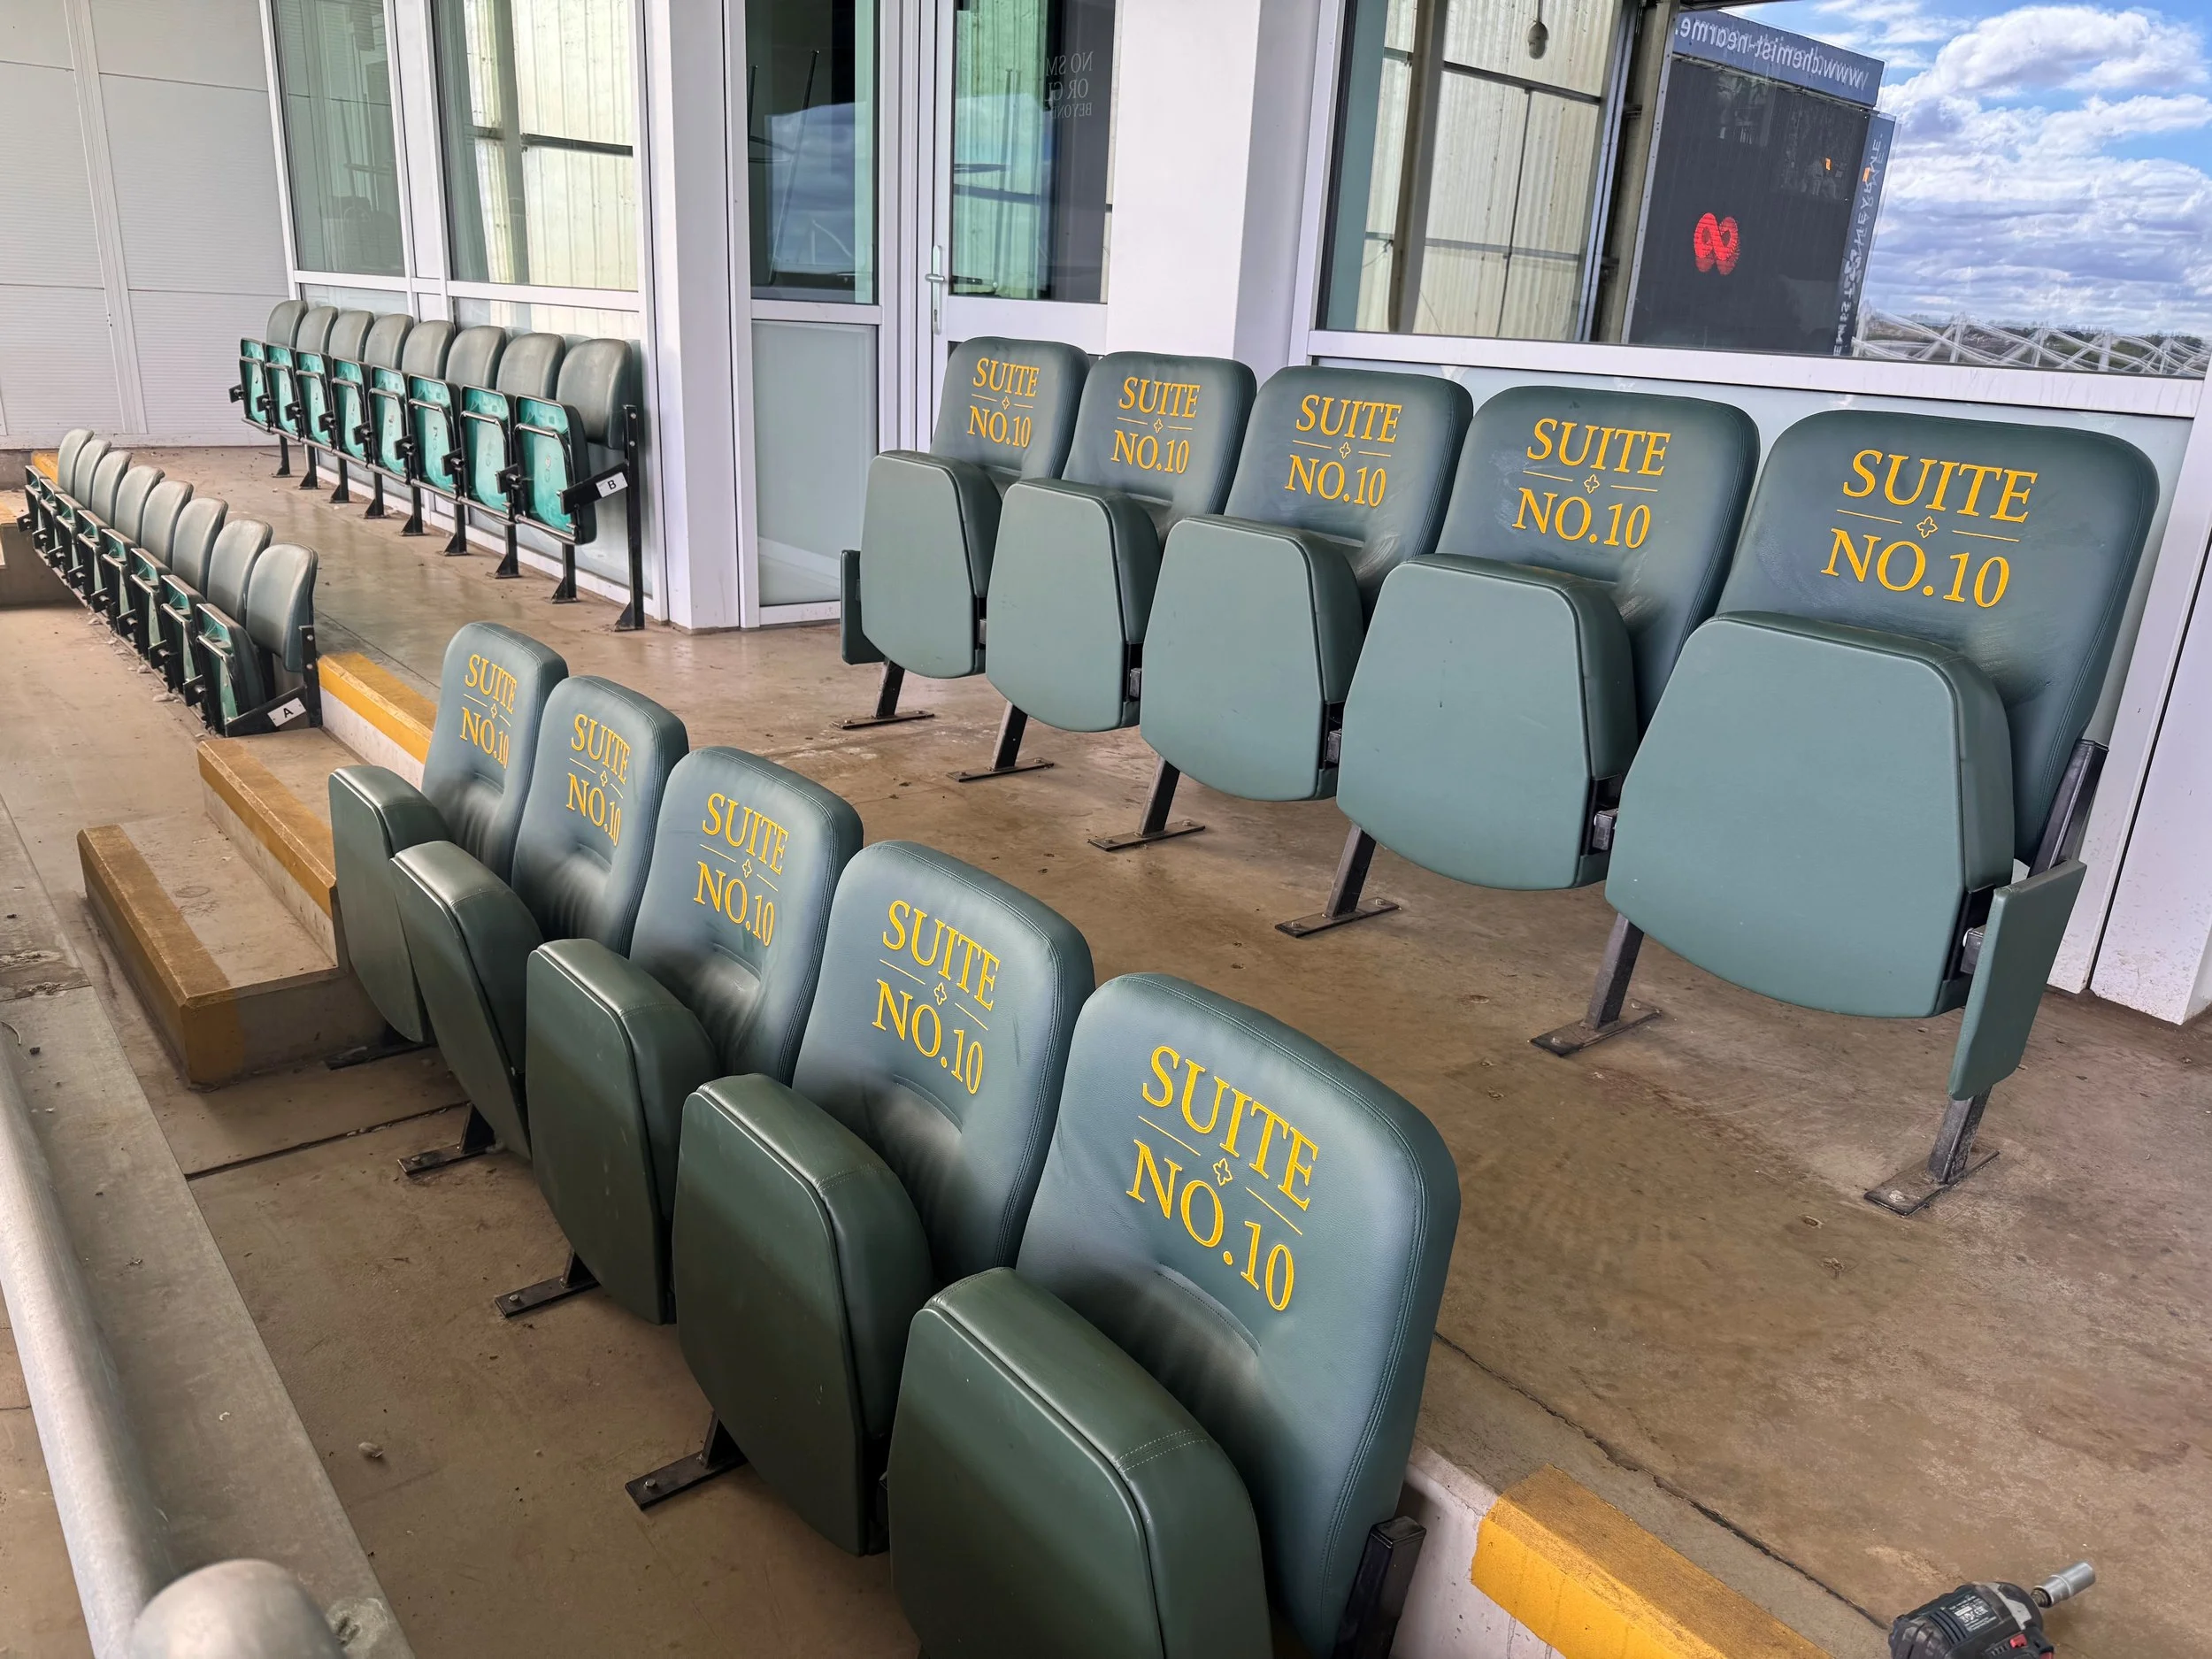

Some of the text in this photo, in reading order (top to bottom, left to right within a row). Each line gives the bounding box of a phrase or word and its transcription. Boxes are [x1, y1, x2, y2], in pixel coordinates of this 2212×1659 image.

[974, 357, 1040, 398] SUITE
[1119, 376, 1202, 419] SUITE
[968, 405, 1033, 449] NO.10
[1295, 394, 1402, 444] SUITE
[1526, 418, 1671, 477] SUITE
[1112, 429, 1190, 474] NO.10
[1286, 454, 1387, 509] NO.10
[608, 480, 617, 490] B
[1842, 449, 2039, 524] SUITE
[1513, 487, 1652, 552] NO.10
[1822, 527, 2011, 609] NO.10
[283, 707, 294, 718] A
[465, 654, 518, 715] SUITE
[460, 707, 509, 771] NO.10
[571, 714, 631, 784] SUITE
[566, 773, 622, 847] NO.10
[702, 792, 789, 876] SUITE
[695, 861, 775, 946] NO.10
[882, 900, 1001, 1010] SUITE
[872, 979, 984, 1095] NO.10
[1141, 1046, 1319, 1211] SUITE
[1126, 1140, 1295, 1312] NO.10
